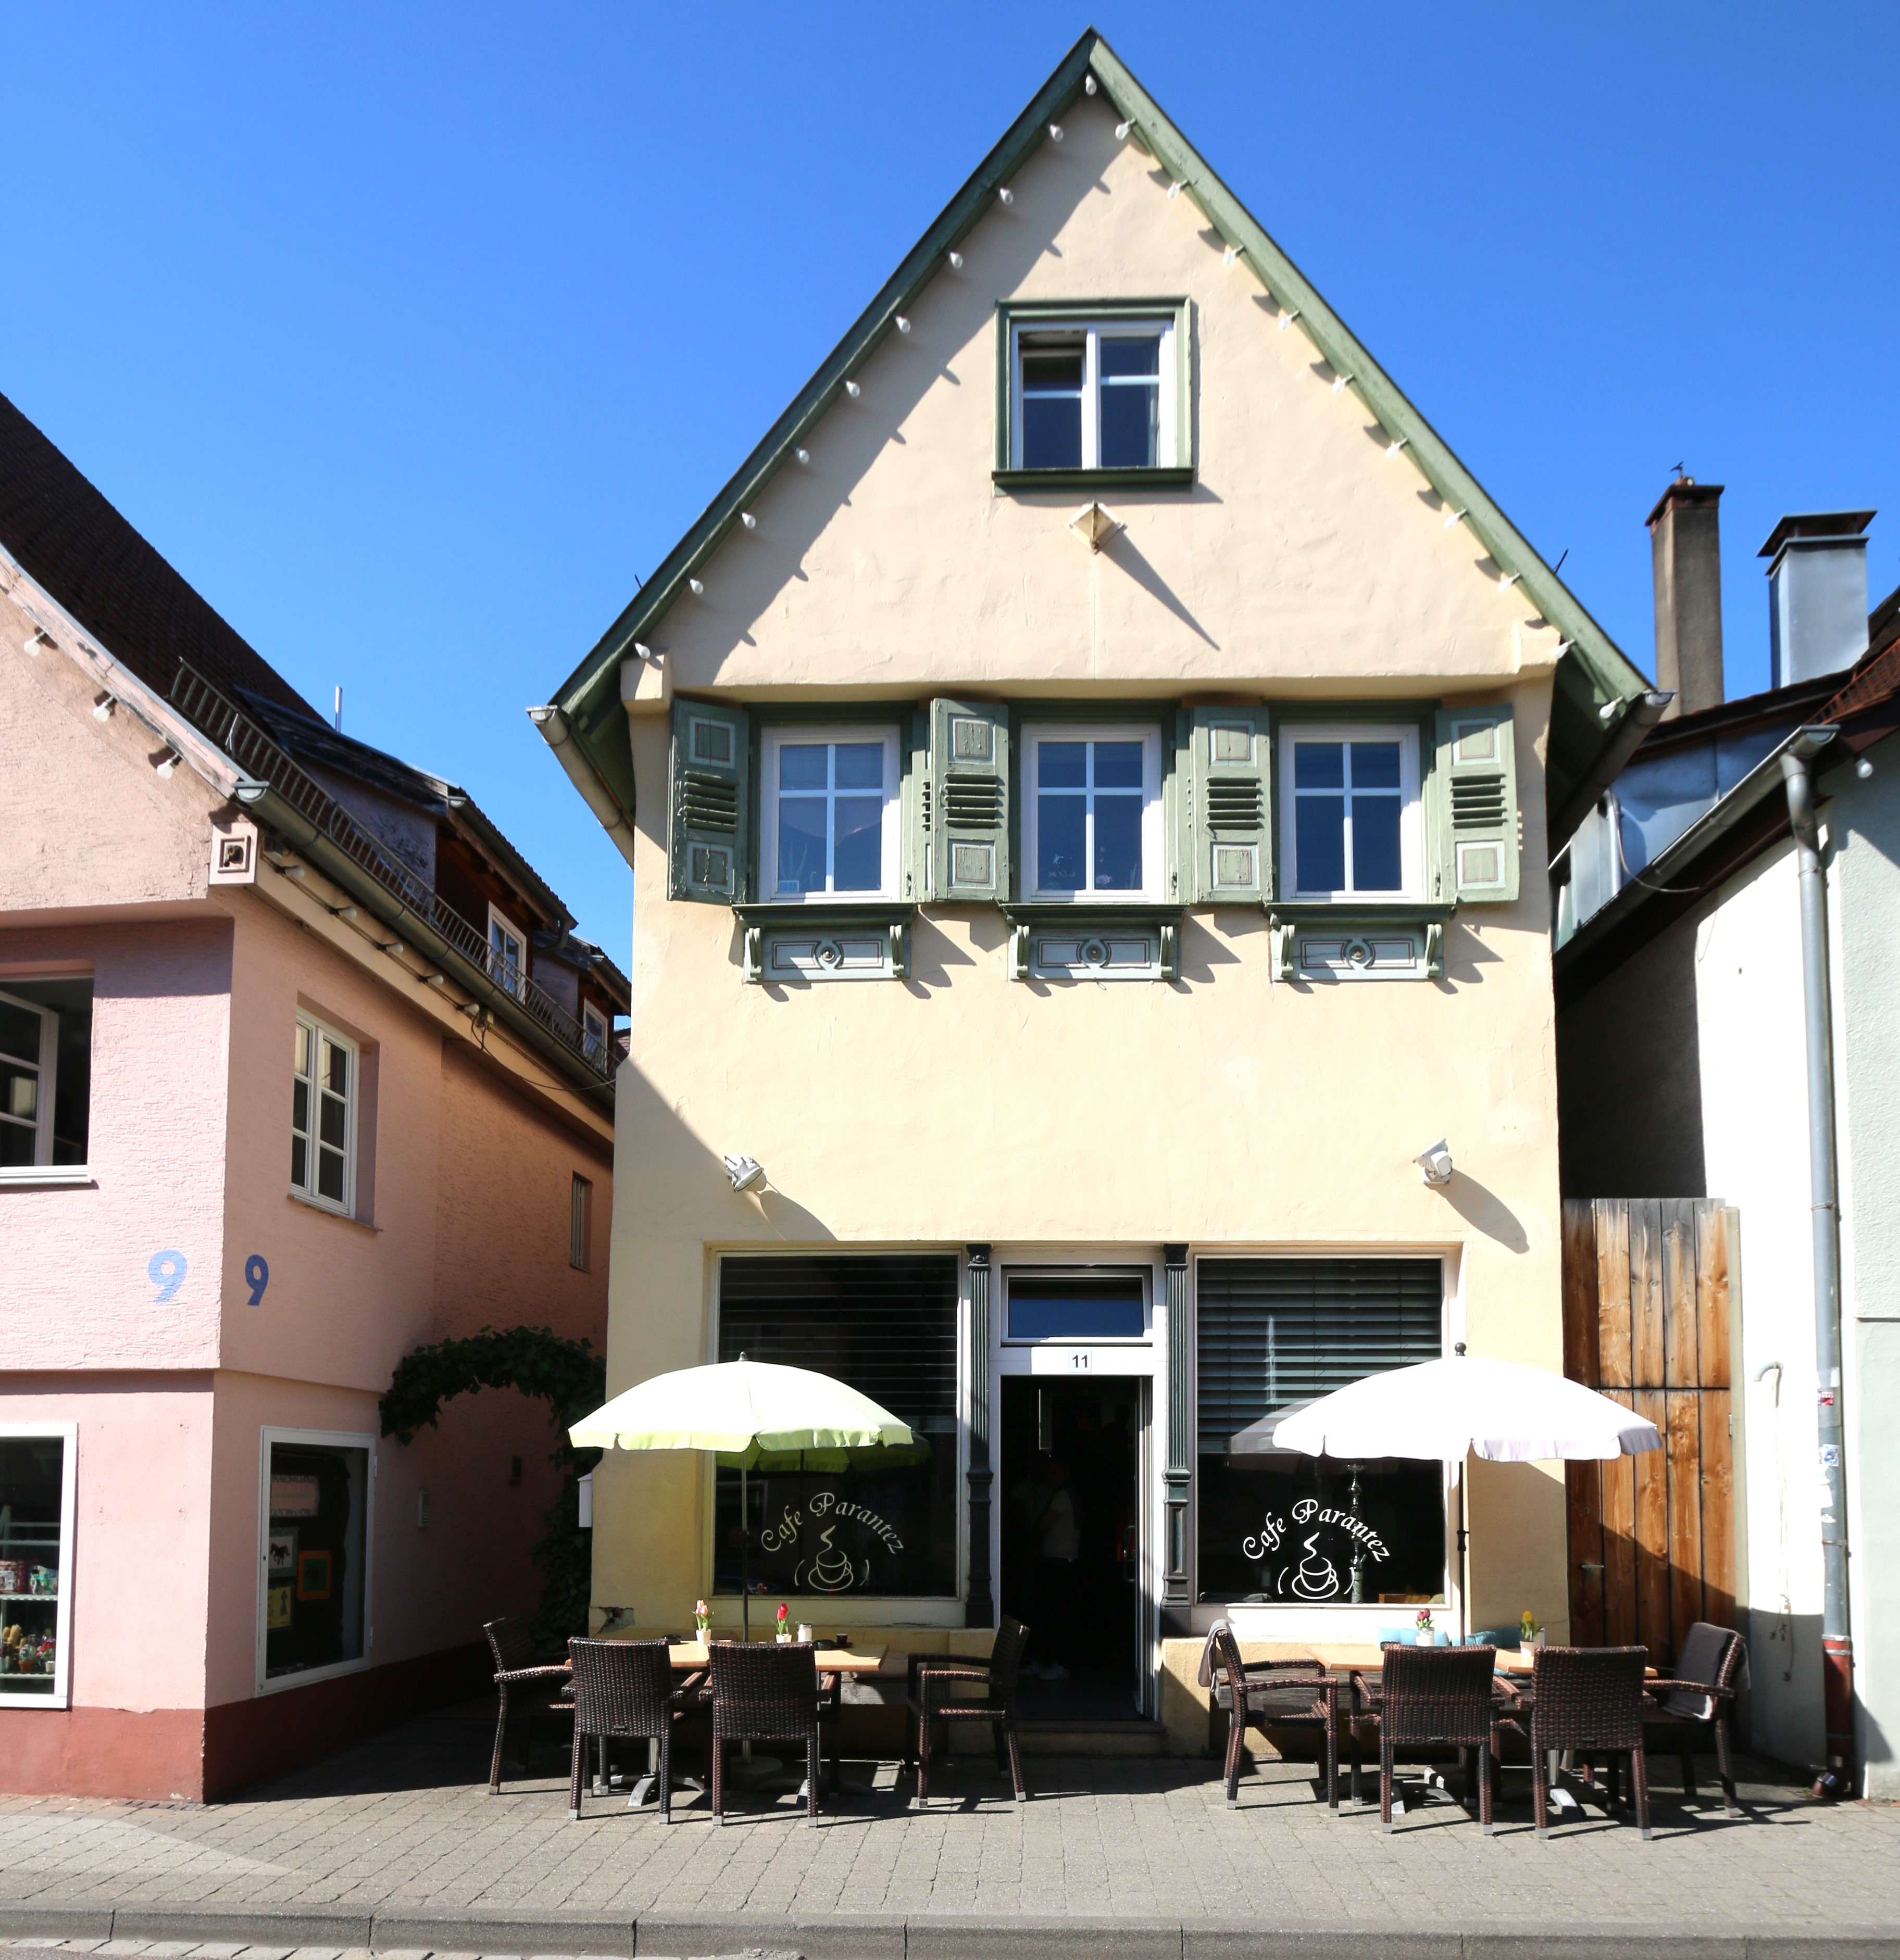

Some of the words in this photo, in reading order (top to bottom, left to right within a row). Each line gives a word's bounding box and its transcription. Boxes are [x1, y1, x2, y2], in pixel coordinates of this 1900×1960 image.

[148, 1249, 188, 1303] 9
[245, 1254, 269, 1305] 9
[1072, 1354, 1088, 1368] 11
[761, 1505, 804, 1552] Cafe
[809, 1492, 904, 1554] Parantez
[1242, 1512, 1287, 1560] Cafe
[1291, 1498, 1390, 1562] Parantez
